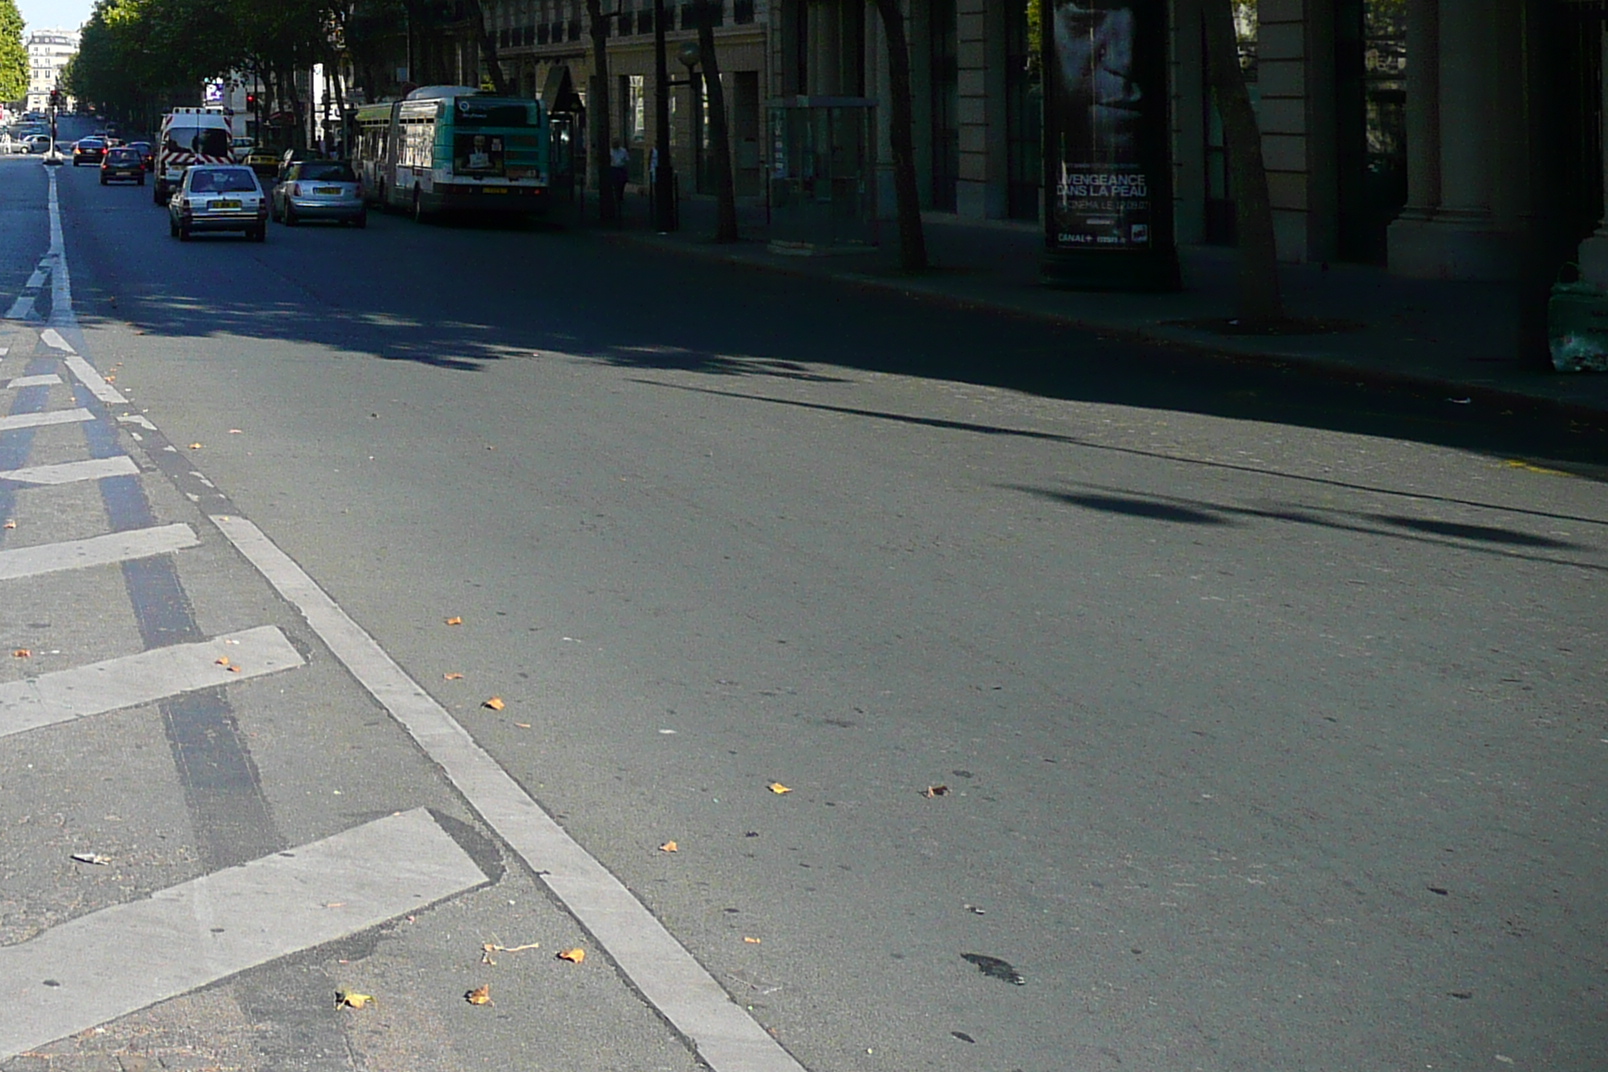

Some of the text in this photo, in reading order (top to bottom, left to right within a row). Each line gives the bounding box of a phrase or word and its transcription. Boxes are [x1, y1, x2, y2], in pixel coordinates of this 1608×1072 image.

[1066, 174, 1146, 186] VENGEANCE
[1056, 184, 1147, 197] DANS LA PEAU
[1058, 232, 1094, 243] CANAL+
